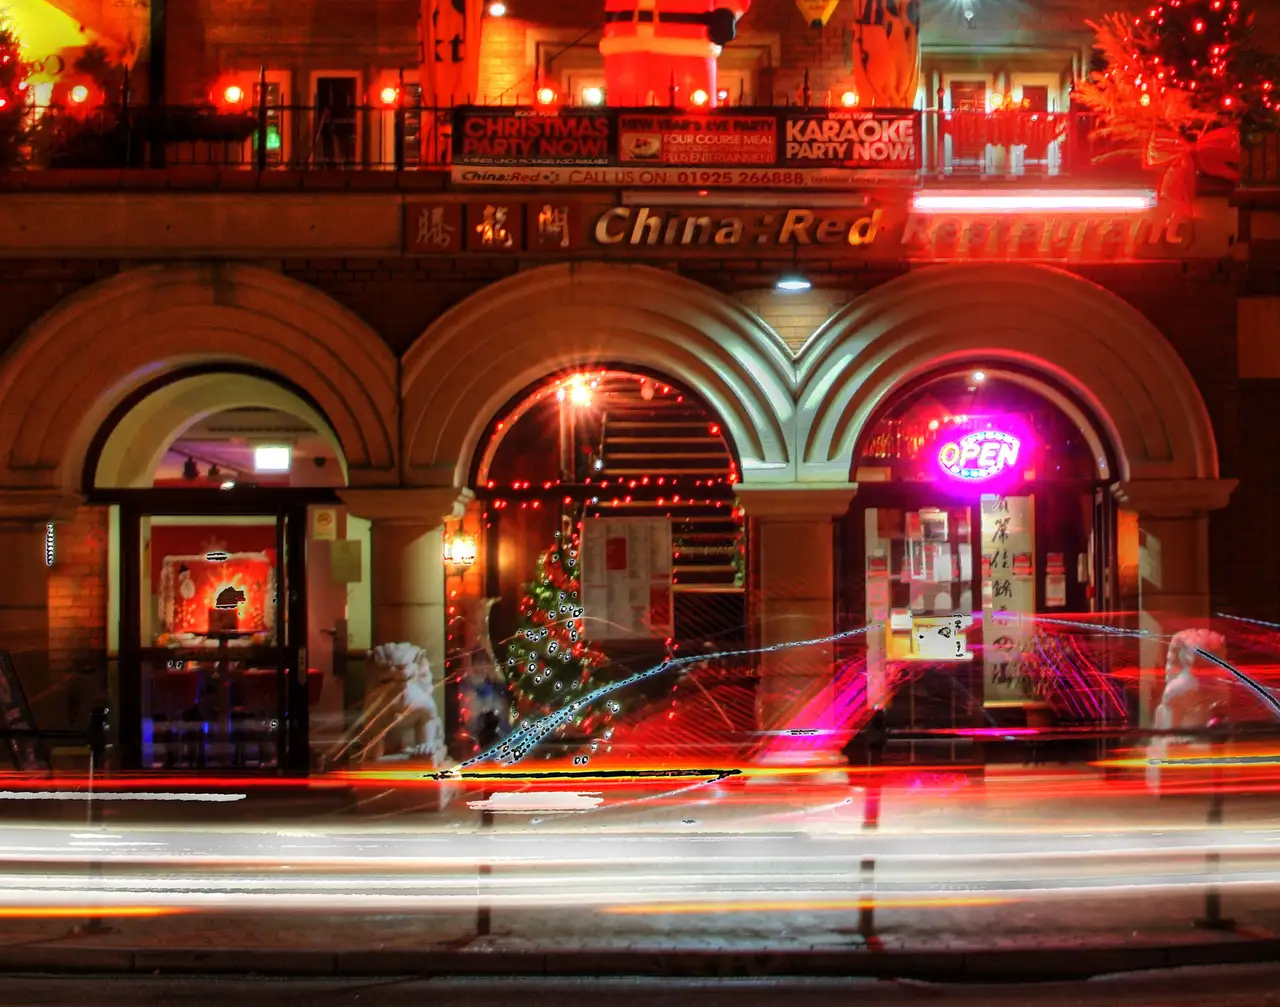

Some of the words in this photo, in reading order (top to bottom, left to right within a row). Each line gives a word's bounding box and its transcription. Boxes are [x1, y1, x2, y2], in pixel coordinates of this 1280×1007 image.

[464, 117, 609, 137] CHRISTMAS
[786, 119, 914, 143] KARAOKE
[464, 137, 535, 157] PARTY
[539, 139, 608, 157] NOW!
[664, 134, 694, 144] FOUR
[695, 134, 740, 144] COURSE
[743, 135, 773, 145] MEAL
[690, 153, 773, 163] ENTERTAINMENT
[786, 143, 846, 159] PARTY
[853, 143, 915, 161] NOW!
[462, 171, 540, 183] China:Red
[569, 171, 611, 183] CALL
[614, 172, 635, 183] US
[677, 172, 732, 184] 01925
[900, 210, 1186, 246] Restaurant
[939, 439, 1020, 470] OPEN
